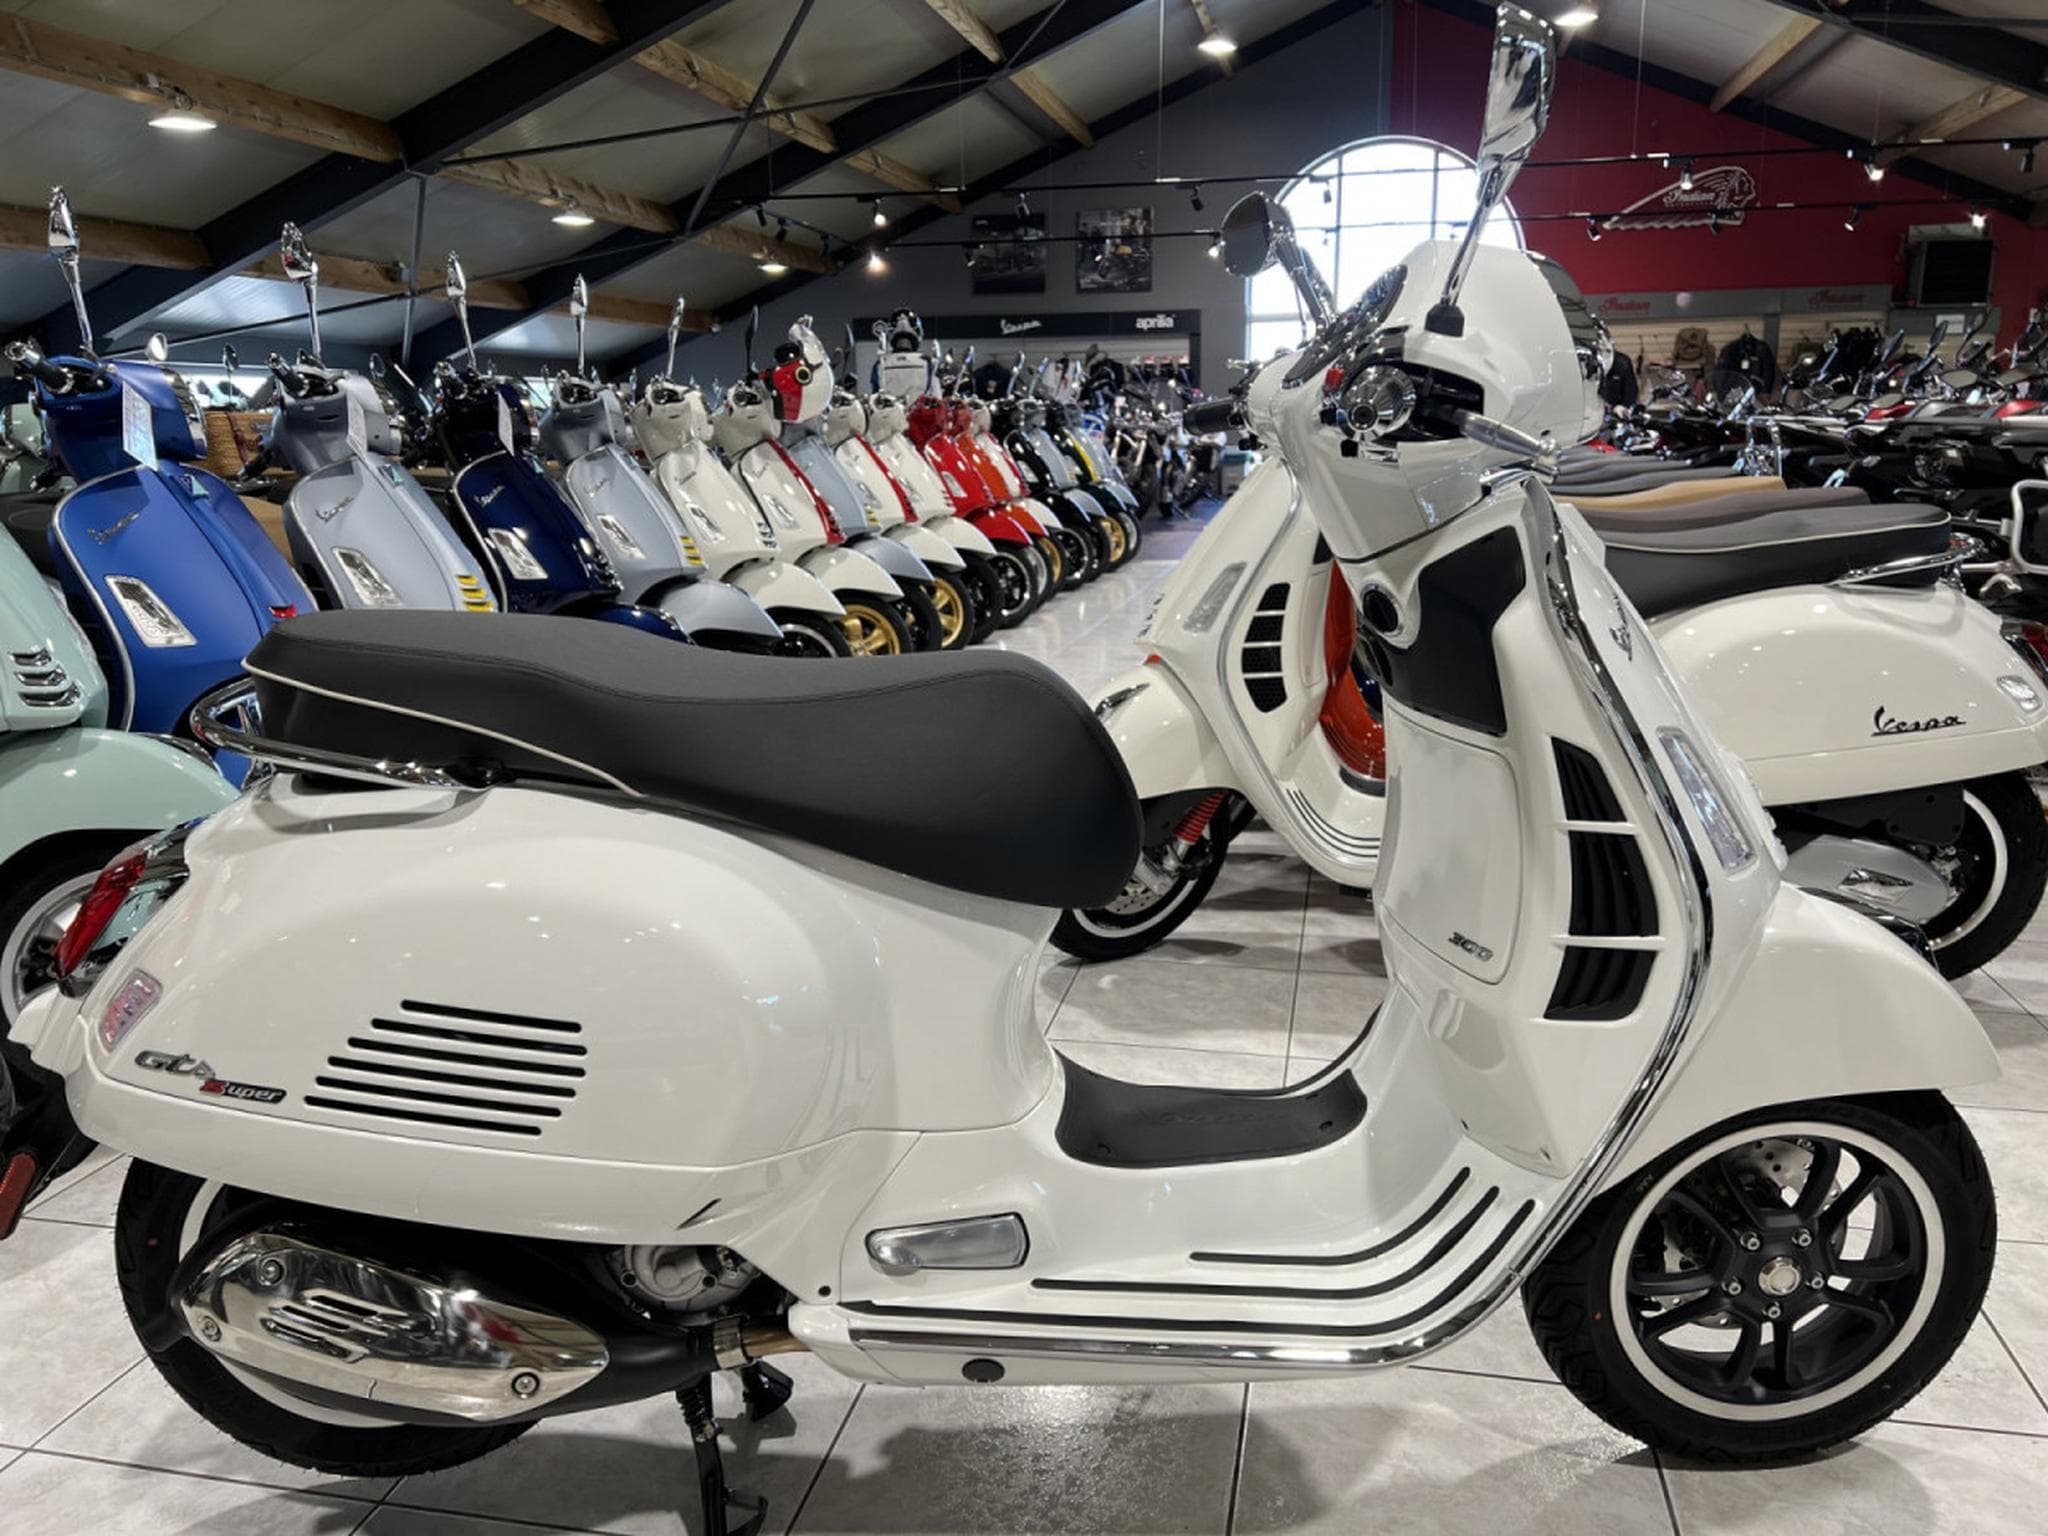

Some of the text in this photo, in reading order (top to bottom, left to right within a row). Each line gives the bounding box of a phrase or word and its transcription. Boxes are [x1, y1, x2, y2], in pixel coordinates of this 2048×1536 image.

[1000, 319, 1042, 334] Vespa
[1135, 314, 1175, 331] aprilia
[1871, 706, 1967, 737] Vespa
[199, 1078, 287, 1104] Super
